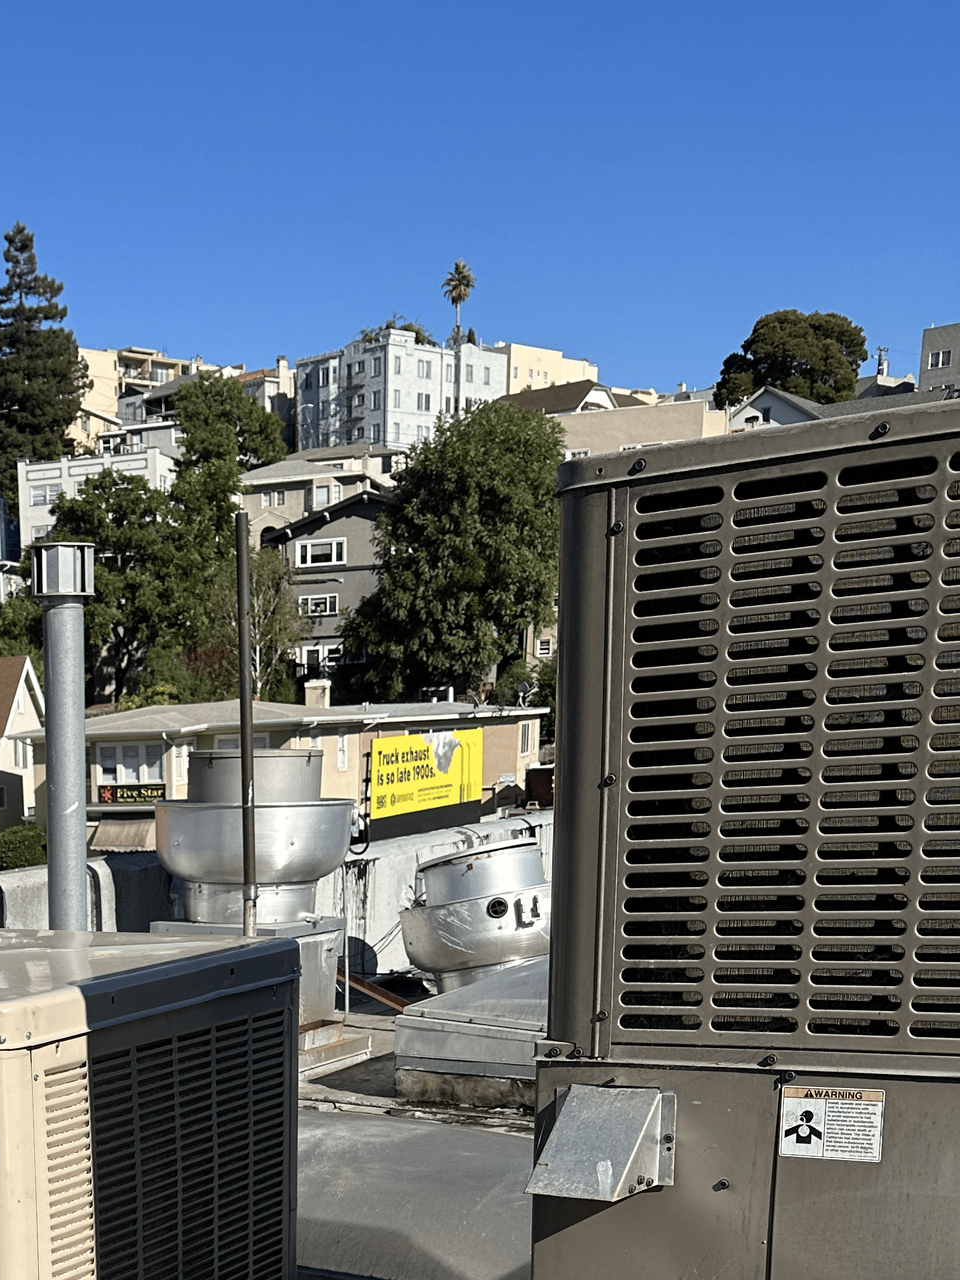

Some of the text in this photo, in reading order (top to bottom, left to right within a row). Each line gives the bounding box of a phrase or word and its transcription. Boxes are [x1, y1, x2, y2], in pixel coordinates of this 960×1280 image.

[378, 746, 430, 766] Truck exhaust
[377, 764, 435, 786] is so late 1900s.
[117, 788, 163, 797] Five Star
[814, 1090, 862, 1100] WARNING
